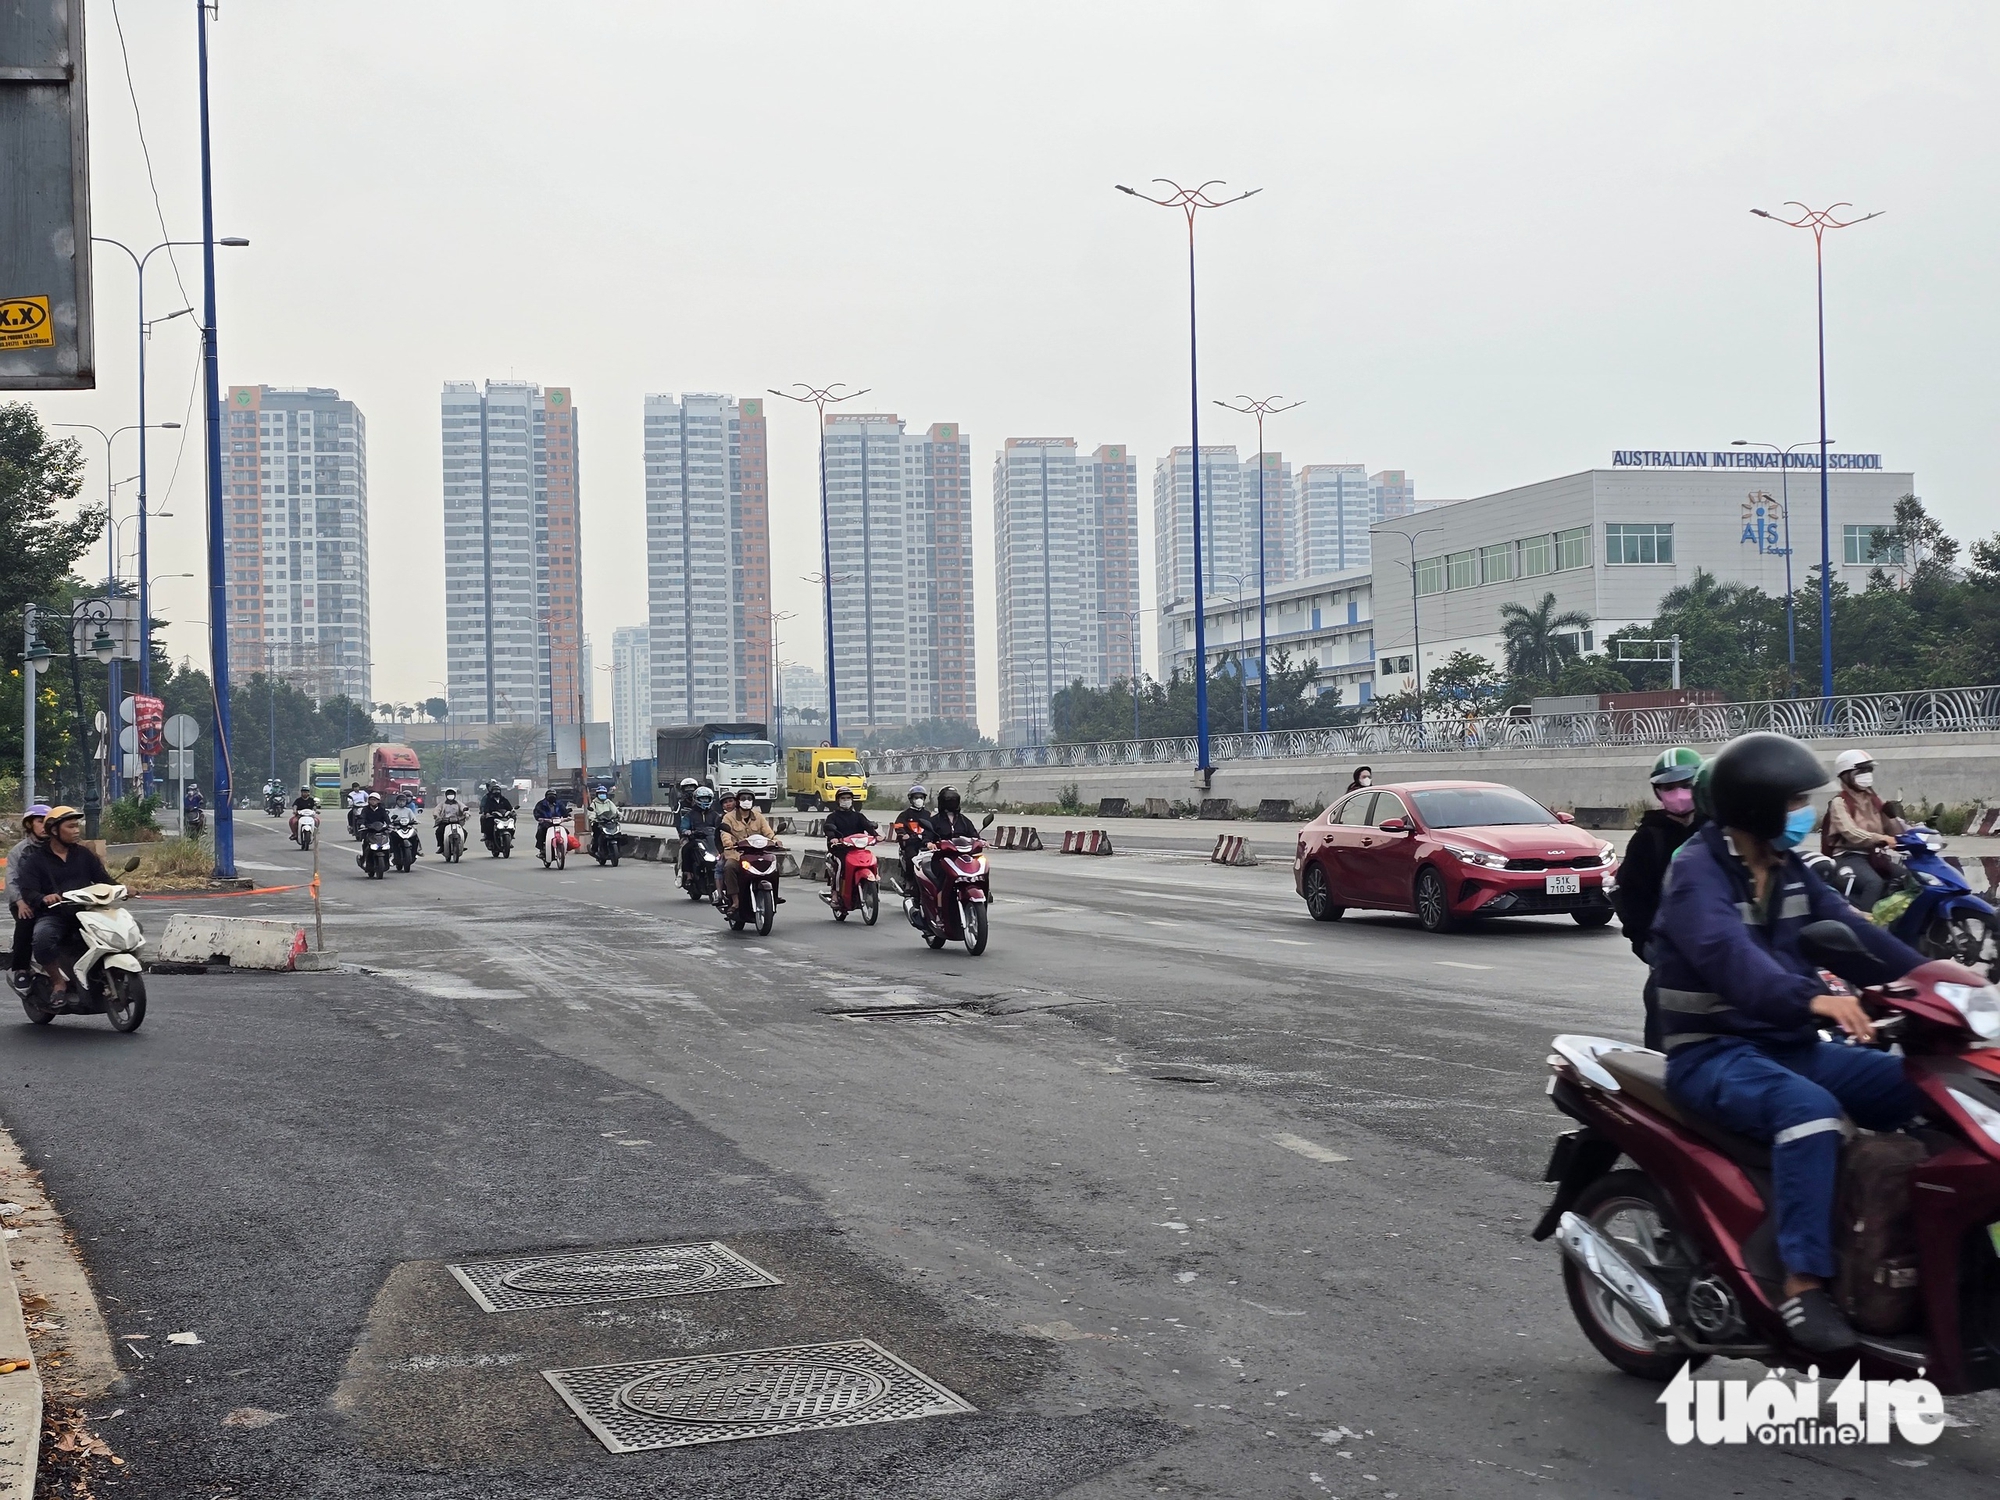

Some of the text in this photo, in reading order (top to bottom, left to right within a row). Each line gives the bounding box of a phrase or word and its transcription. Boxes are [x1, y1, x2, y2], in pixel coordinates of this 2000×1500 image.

[1613, 450, 1883, 469] AUSTRALIAN INTERNATIONAL SCHOOL
[1555, 877, 1570, 885] 51K
[1550, 885, 1577, 893] 710.92
